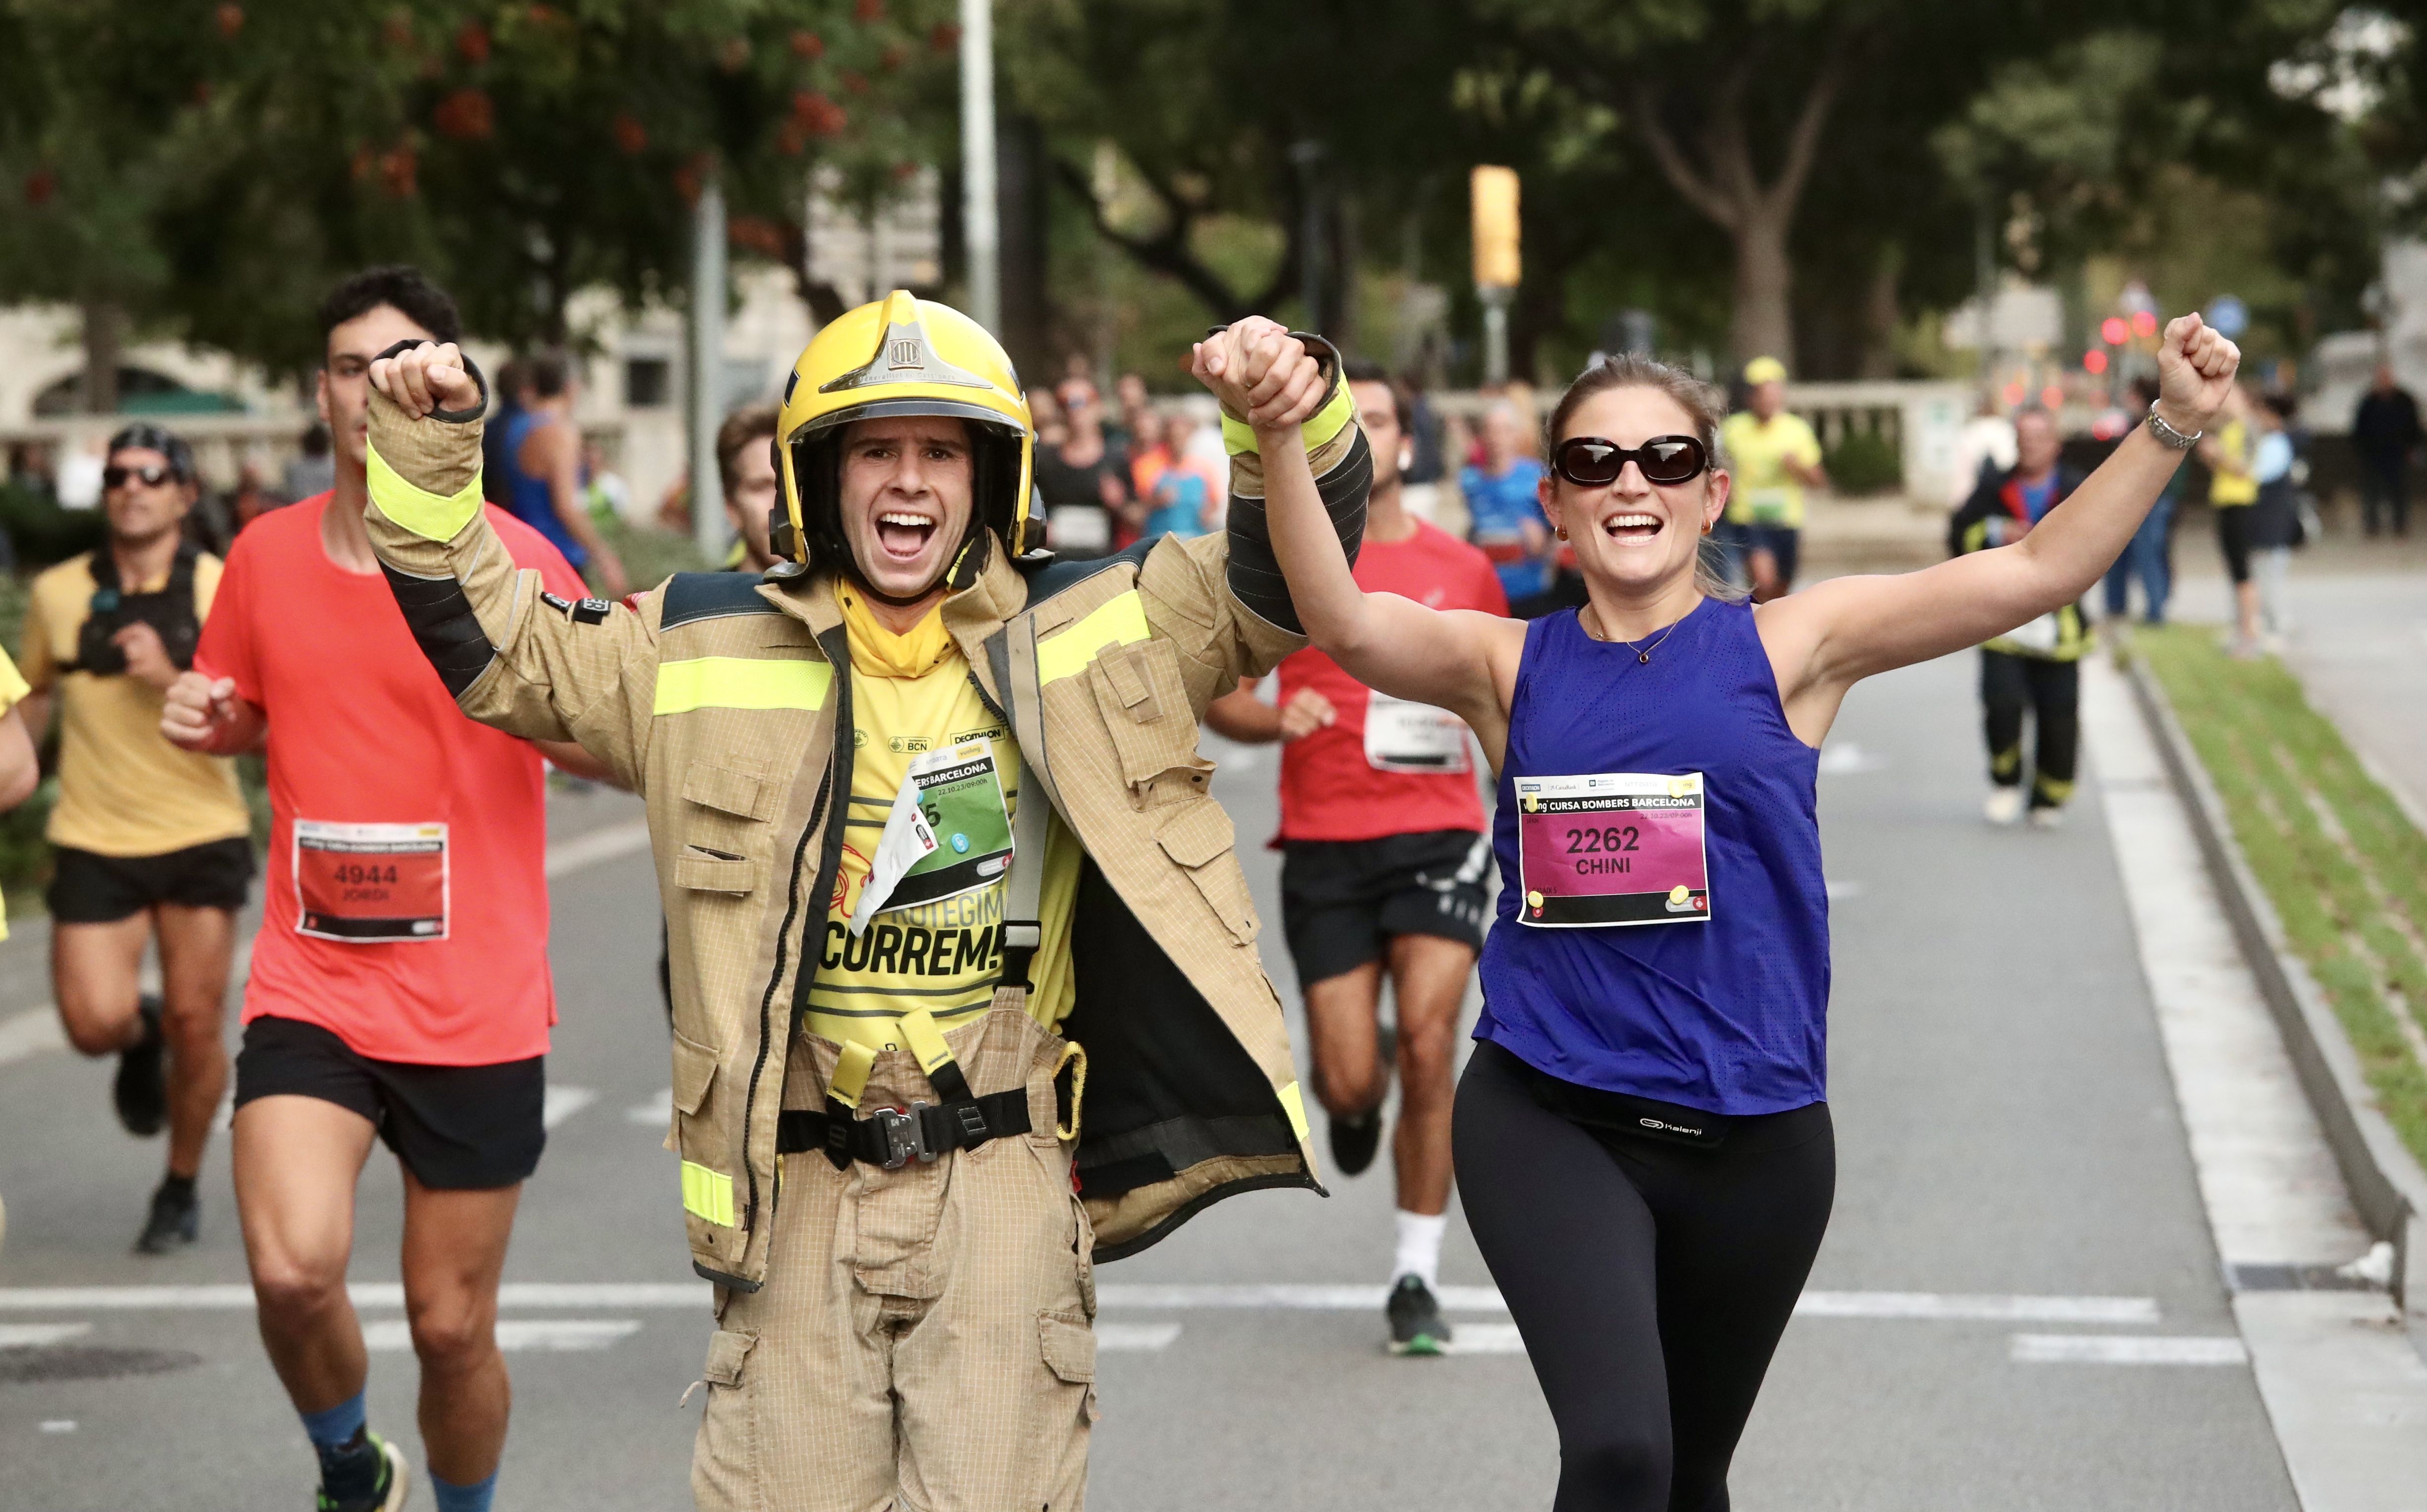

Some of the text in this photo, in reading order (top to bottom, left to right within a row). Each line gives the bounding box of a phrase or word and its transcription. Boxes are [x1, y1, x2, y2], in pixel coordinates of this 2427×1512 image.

[908, 743, 927, 751] BCN
[960, 746, 981, 756] vueling
[930, 762, 987, 785] BARCELONA
[938, 778, 987, 796] 22.10.23/09:00h
[1549, 801, 1580, 810] CURSA
[1582, 799, 1630, 809] BOMBERS
[1632, 798, 1695, 807] BARCELONA
[1566, 826, 1640, 854] 2262
[334, 864, 398, 884] 4944
[1576, 857, 1630, 875] CHINI
[820, 921, 1005, 976] CORREM!
[1665, 1123, 1702, 1136] Kalenji
